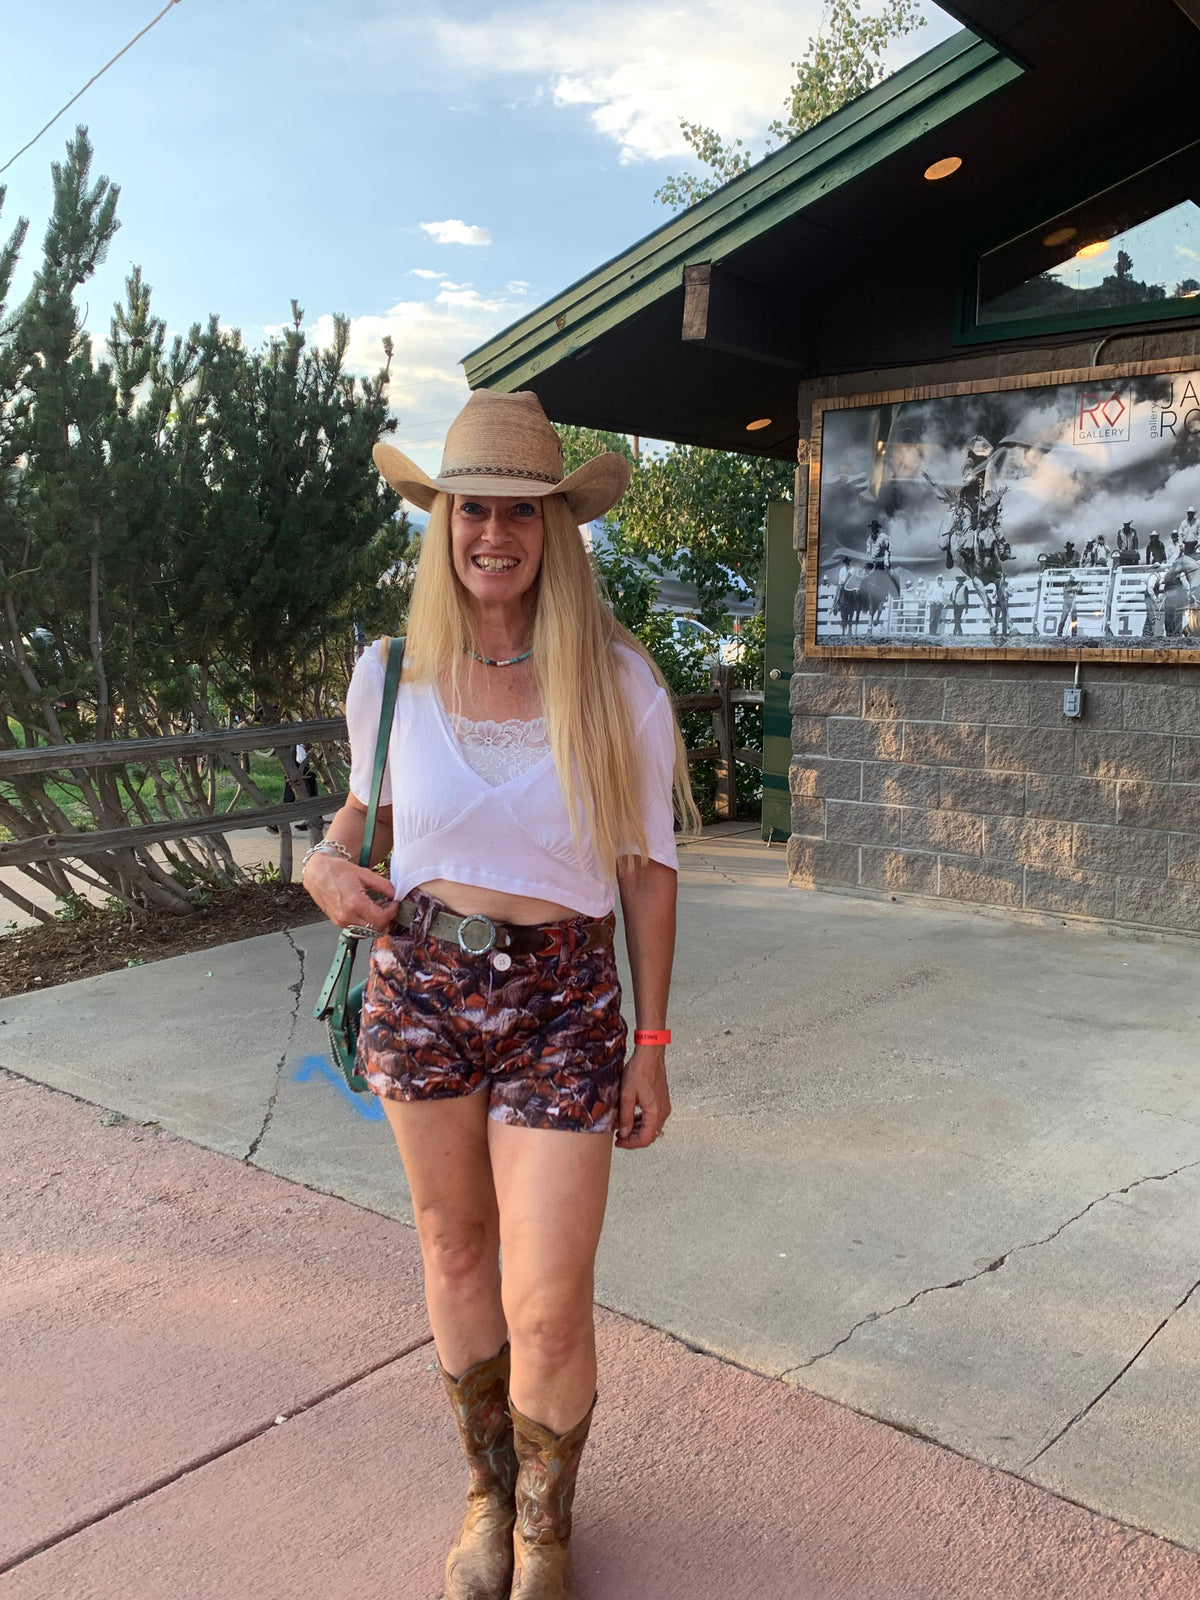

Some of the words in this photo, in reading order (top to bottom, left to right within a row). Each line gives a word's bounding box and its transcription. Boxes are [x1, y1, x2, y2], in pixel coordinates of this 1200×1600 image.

[1160, 380, 1200, 409] JA
[1149, 402, 1160, 439] gallery
[1079, 428, 1124, 439] GALLERY
[1118, 615, 1133, 635] 1
